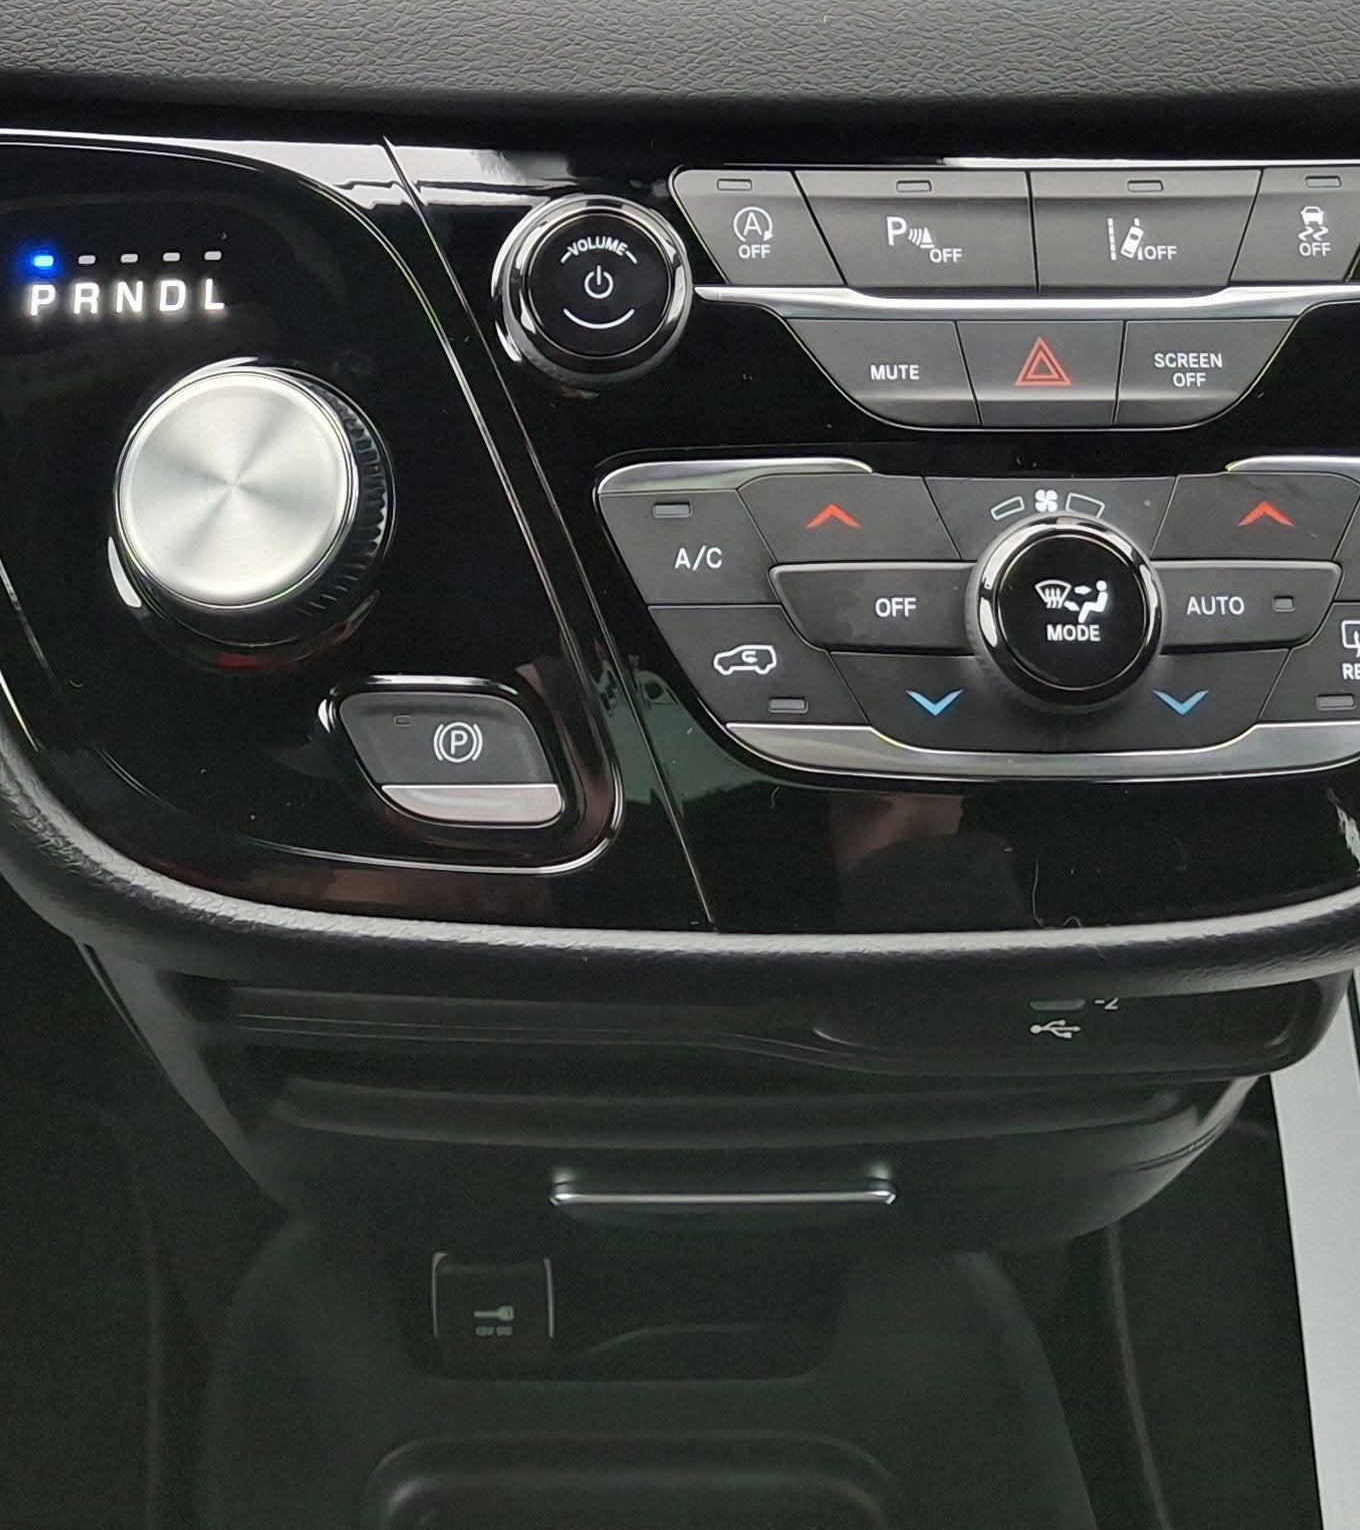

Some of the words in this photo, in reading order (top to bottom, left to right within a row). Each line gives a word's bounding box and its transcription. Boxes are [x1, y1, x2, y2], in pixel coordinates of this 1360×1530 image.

[567, 236, 628, 257] VOLUME
[738, 244, 771, 260] OFF
[1144, 244, 1178, 261] OFF
[1299, 242, 1331, 258] OFF
[929, 248, 963, 265] OFF
[1154, 352, 1223, 370] SCREEN
[870, 364, 920, 381] MUTE
[1172, 371, 1207, 388] OFF
[674, 546, 722, 571] A/C
[875, 597, 917, 618] OFF
[1187, 596, 1245, 616] AUTO
[1047, 625, 1101, 642] MODE
